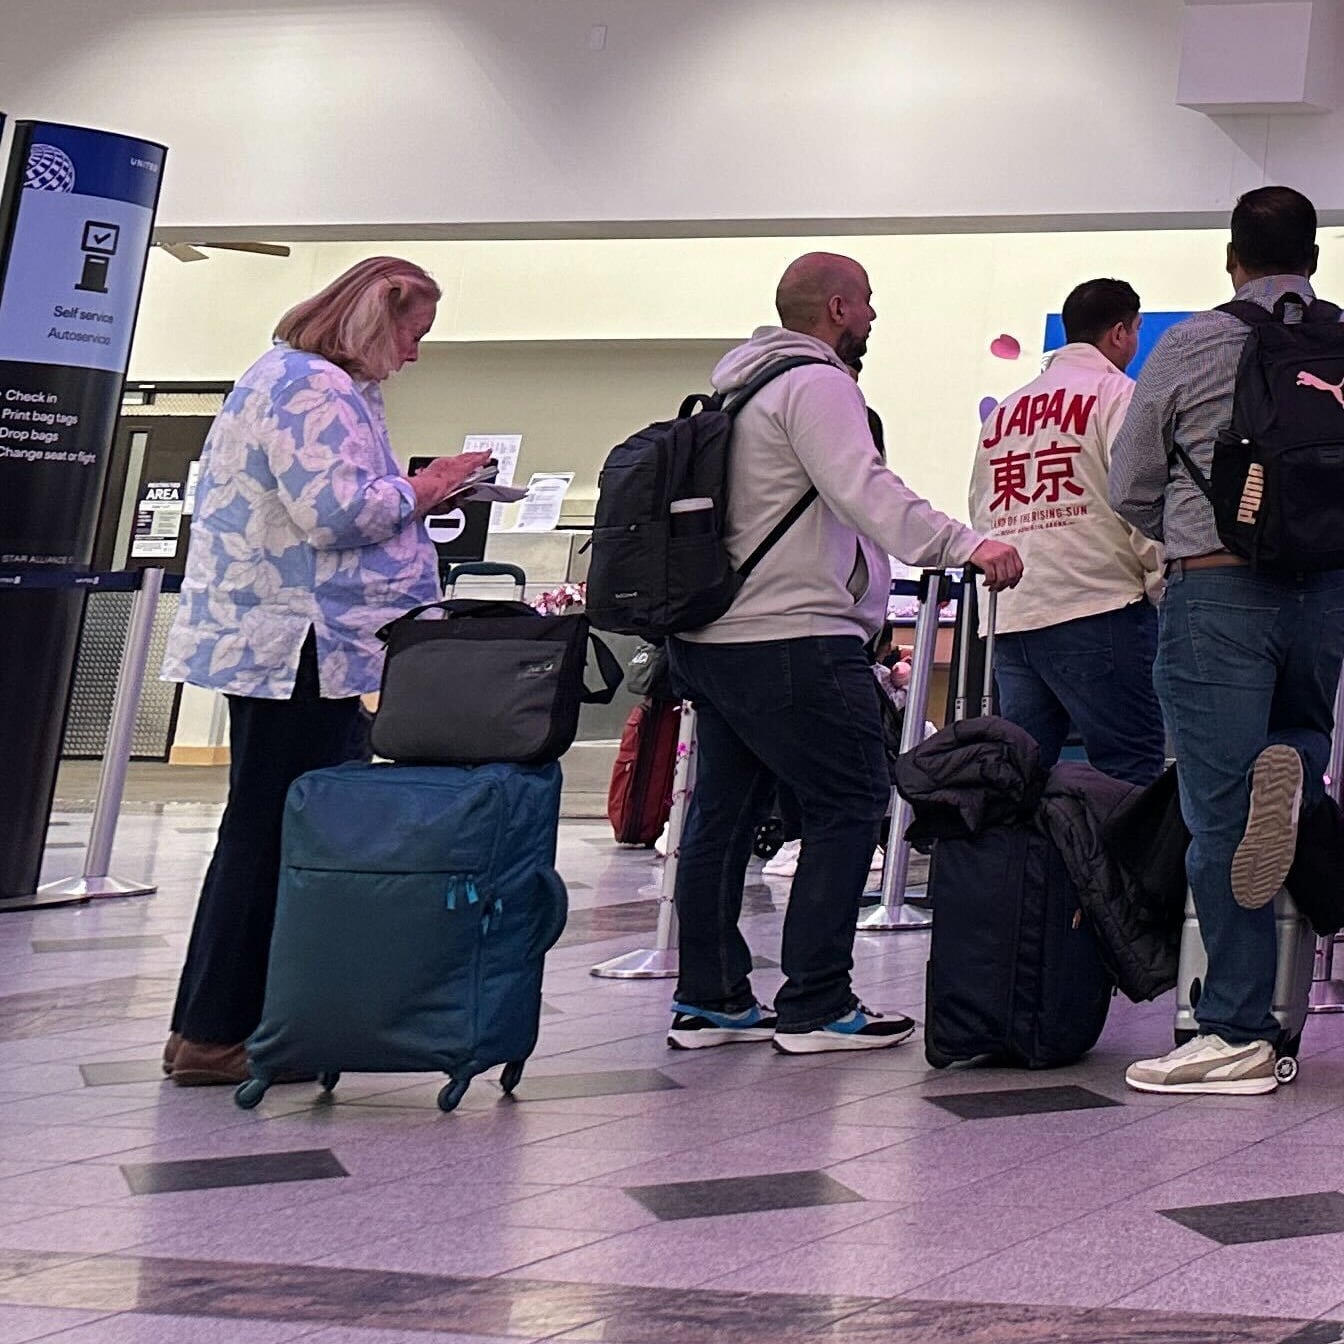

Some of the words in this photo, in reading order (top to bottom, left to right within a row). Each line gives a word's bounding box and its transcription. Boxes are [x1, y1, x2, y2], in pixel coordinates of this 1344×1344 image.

[130, 157, 158, 173] UNITED
[53, 305, 79, 318] Self
[79, 310, 114, 324] service
[5, 389, 46, 403] Check
[46, 393, 58, 404] in
[1, 408, 31, 420] Print
[32, 410, 55, 425] bag
[56, 413, 79, 427] tags
[982, 388, 1098, 449] JAPAN
[0, 427, 29, 442] Drop
[30, 429, 59, 444] bags
[0, 445, 43, 462] Change
[43, 450, 67, 461] seat
[67, 452, 77, 462] or
[988, 441, 1084, 512] 東京
[146, 488, 180, 500] AREA
[1236, 462, 1265, 525] PUMA
[1007, 515, 1019, 526] OF
[1031, 507, 1064, 522] RISING
[1065, 505, 1088, 517] SUN
